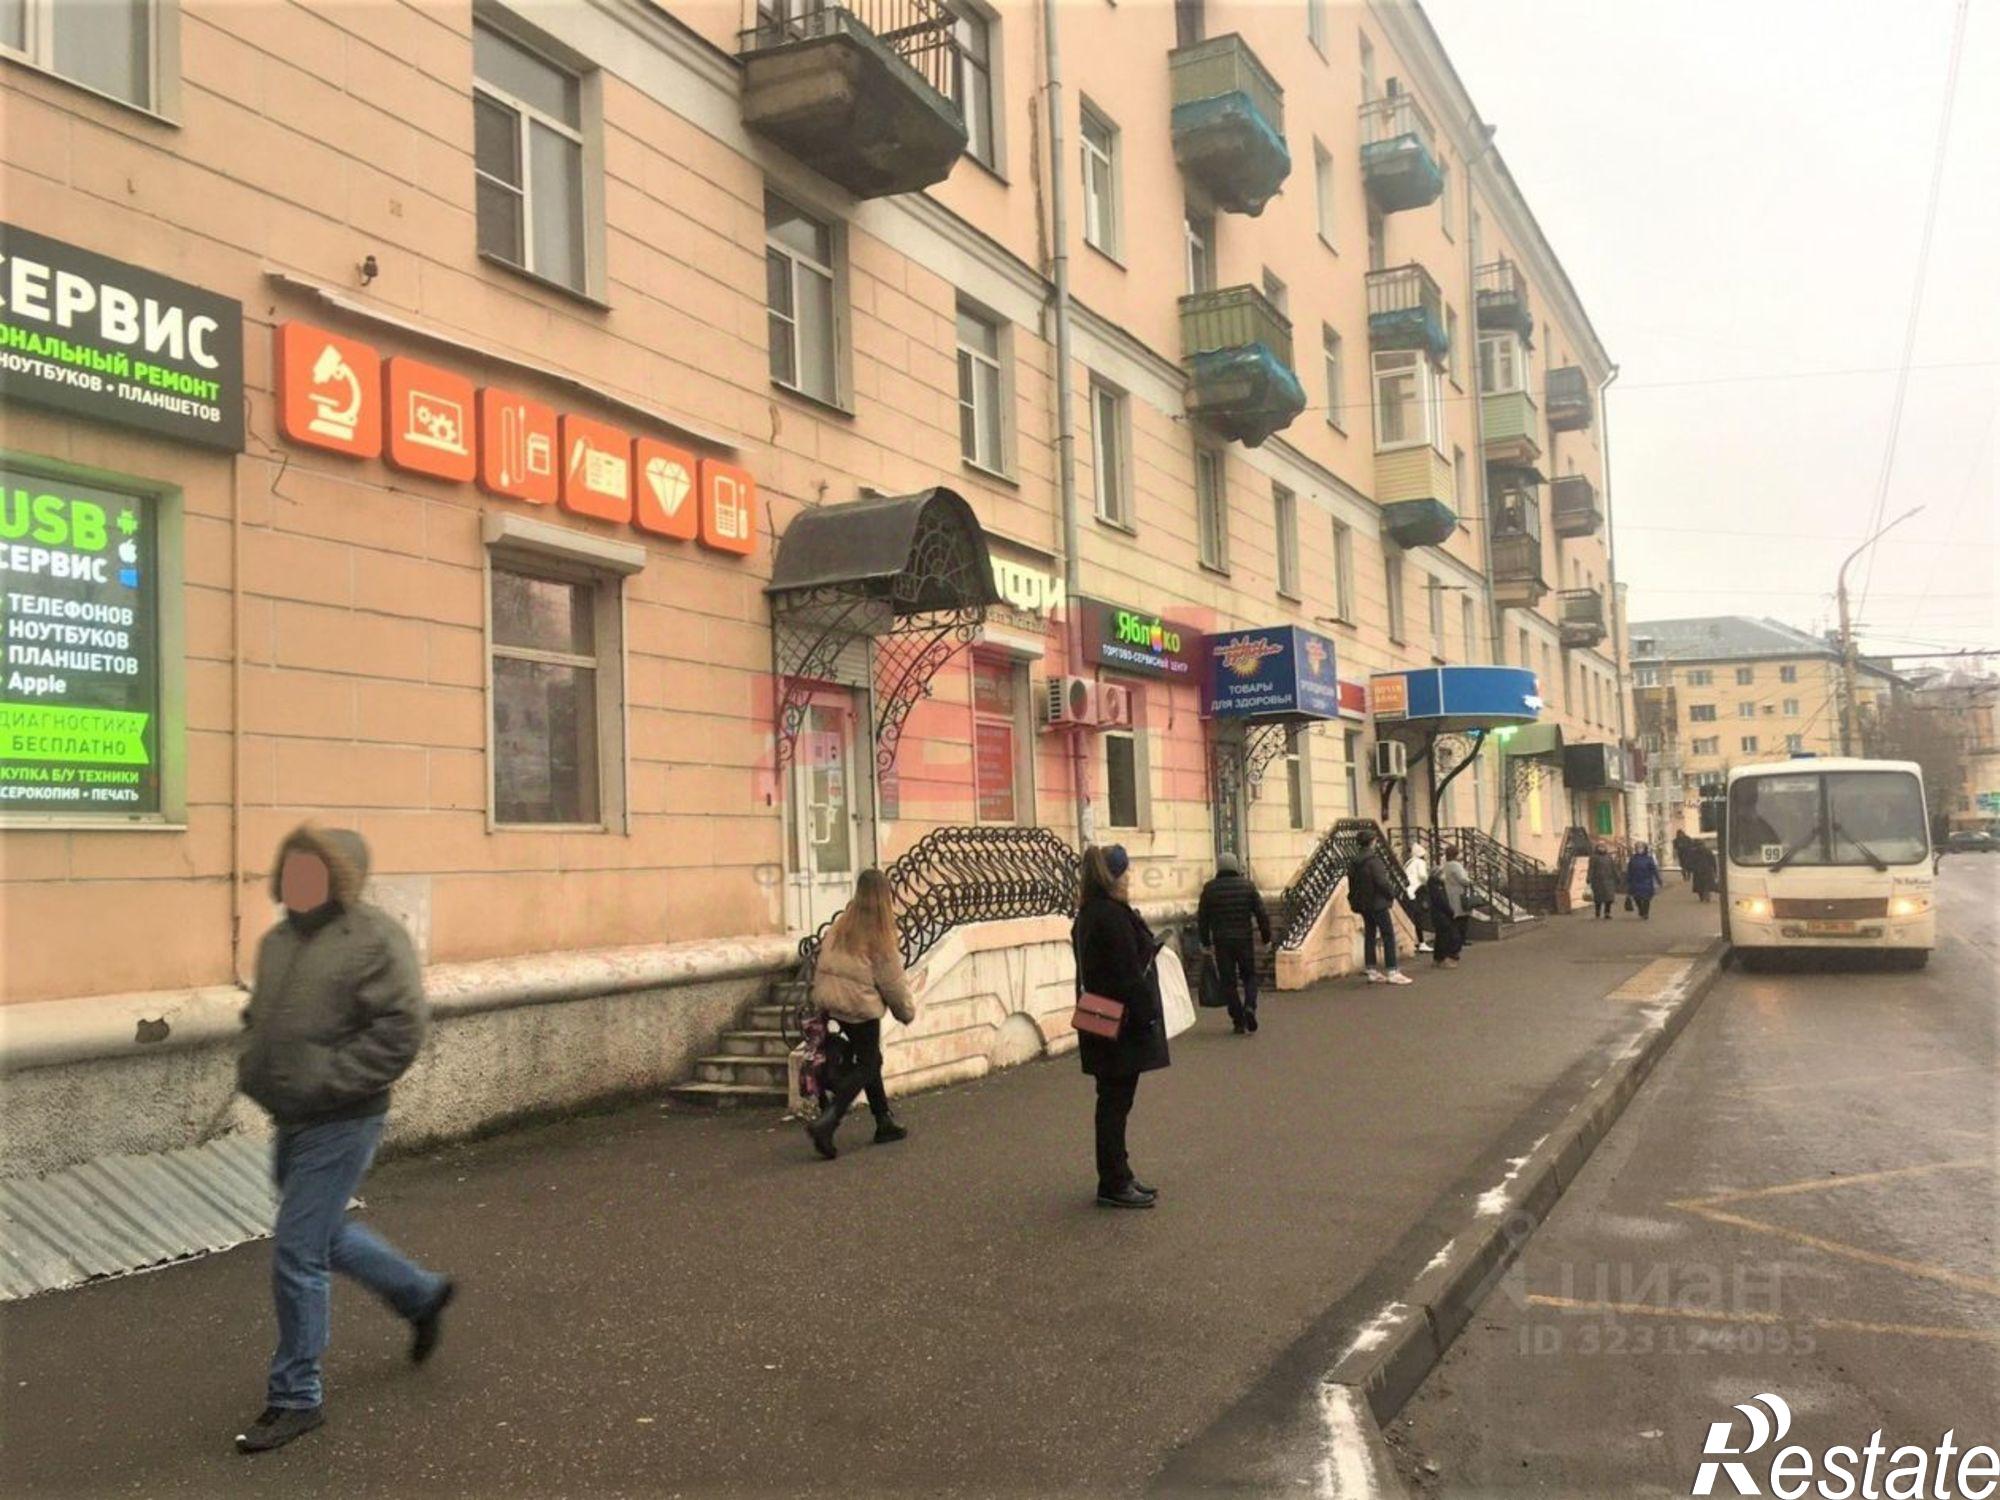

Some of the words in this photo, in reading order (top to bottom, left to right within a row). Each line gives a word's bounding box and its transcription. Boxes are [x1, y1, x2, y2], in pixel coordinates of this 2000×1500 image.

[0, 255, 220, 369] ЕРВИС
[134, 361, 221, 401] РЕМОНТ
[118, 383, 221, 423] ПЛАНШЕТОВ
[0, 486, 109, 552] USB
[7, 592, 134, 626] ТЕЛЕФОНОВ
[8, 619, 130, 650] НОУТБУКОВ
[8, 645, 139, 675] ПЛАНШЕТОВ
[7, 670, 67, 696] Apple
[1227, 681, 1274, 695] ТОВАРЫ
[1210, 699, 1234, 711] ДЛЯ
[1235, 693, 1293, 710] ЗДОРОВЬЯ
[12, 735, 127, 756] БЕСПЛАТНО
[78, 770, 140, 785] ТЕХНИКИ
[91, 787, 140, 802] ПЕЧАТЬ
[1764, 848, 1780, 861] 99
